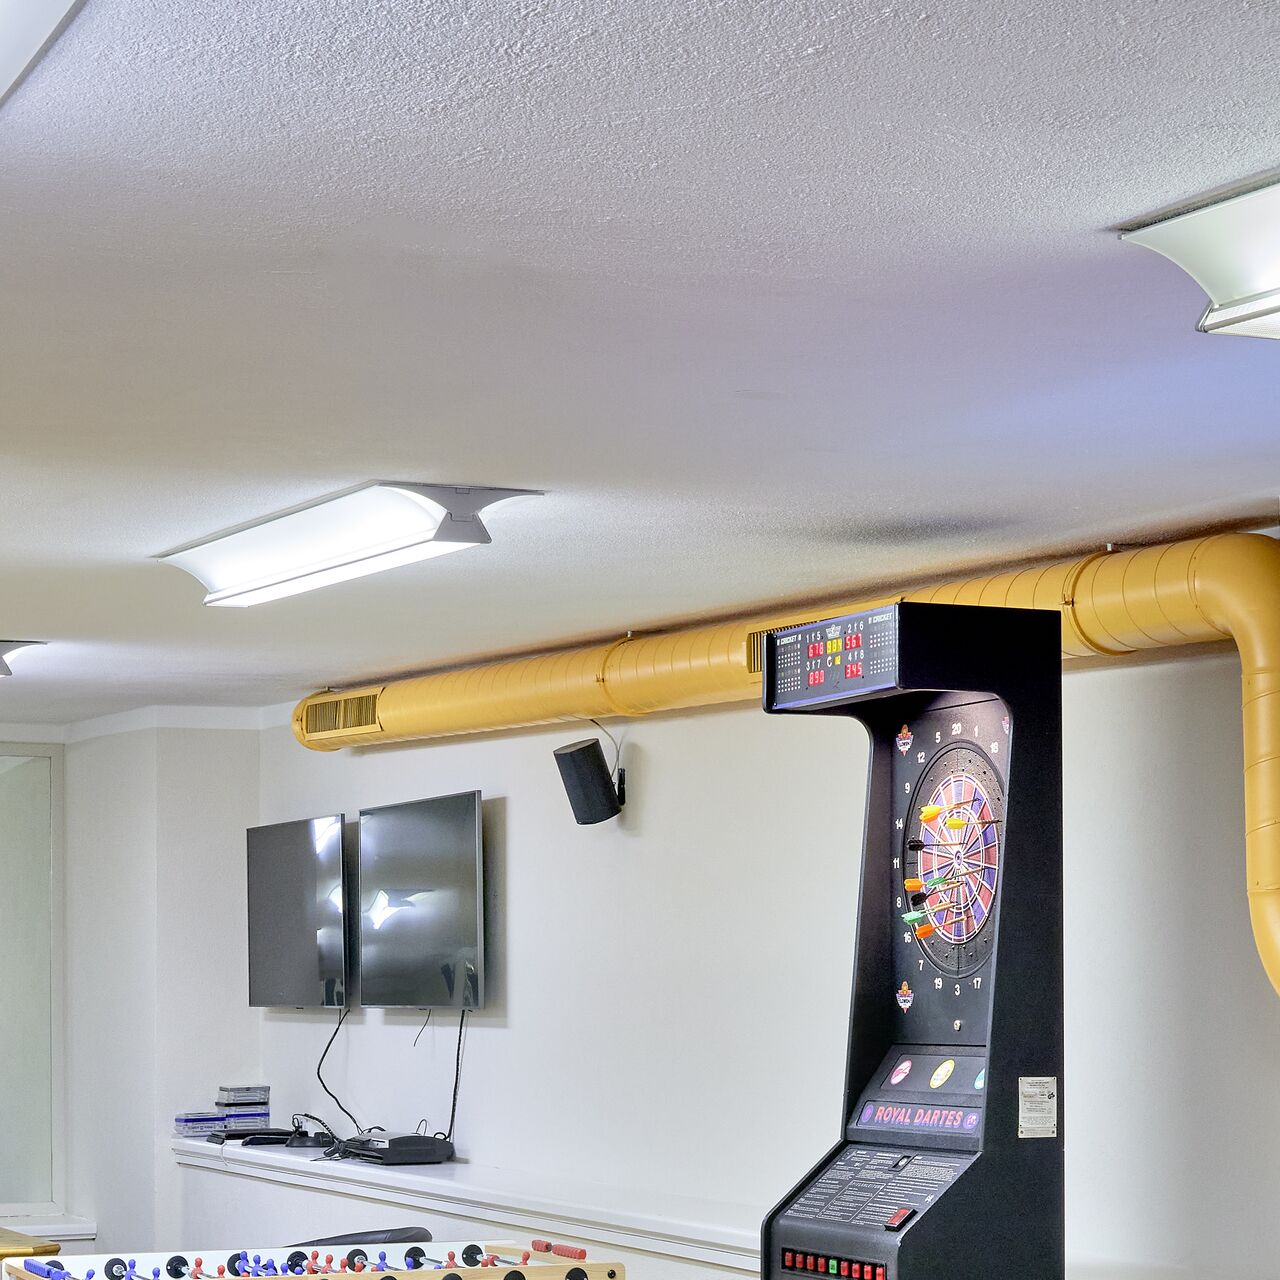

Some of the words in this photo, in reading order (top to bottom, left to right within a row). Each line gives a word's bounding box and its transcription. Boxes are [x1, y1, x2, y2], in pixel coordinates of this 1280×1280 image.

[951, 722, 962, 736] 20
[974, 725, 979, 737] 1
[935, 731, 941, 744] 5
[990, 742, 999, 754] 18
[917, 751, 926, 764] 12
[904, 782, 911, 794] 9
[895, 818, 904, 830] 14
[892, 857, 900, 869] 11
[896, 896, 902, 908] 8
[903, 931, 912, 943] 16
[918, 959, 924, 971] 7
[933, 977, 943, 989] 19
[973, 977, 982, 989] 17
[954, 983, 961, 996] 3
[874, 1106, 912, 1123] ROYAL
[913, 1108, 964, 1127] DARTES
